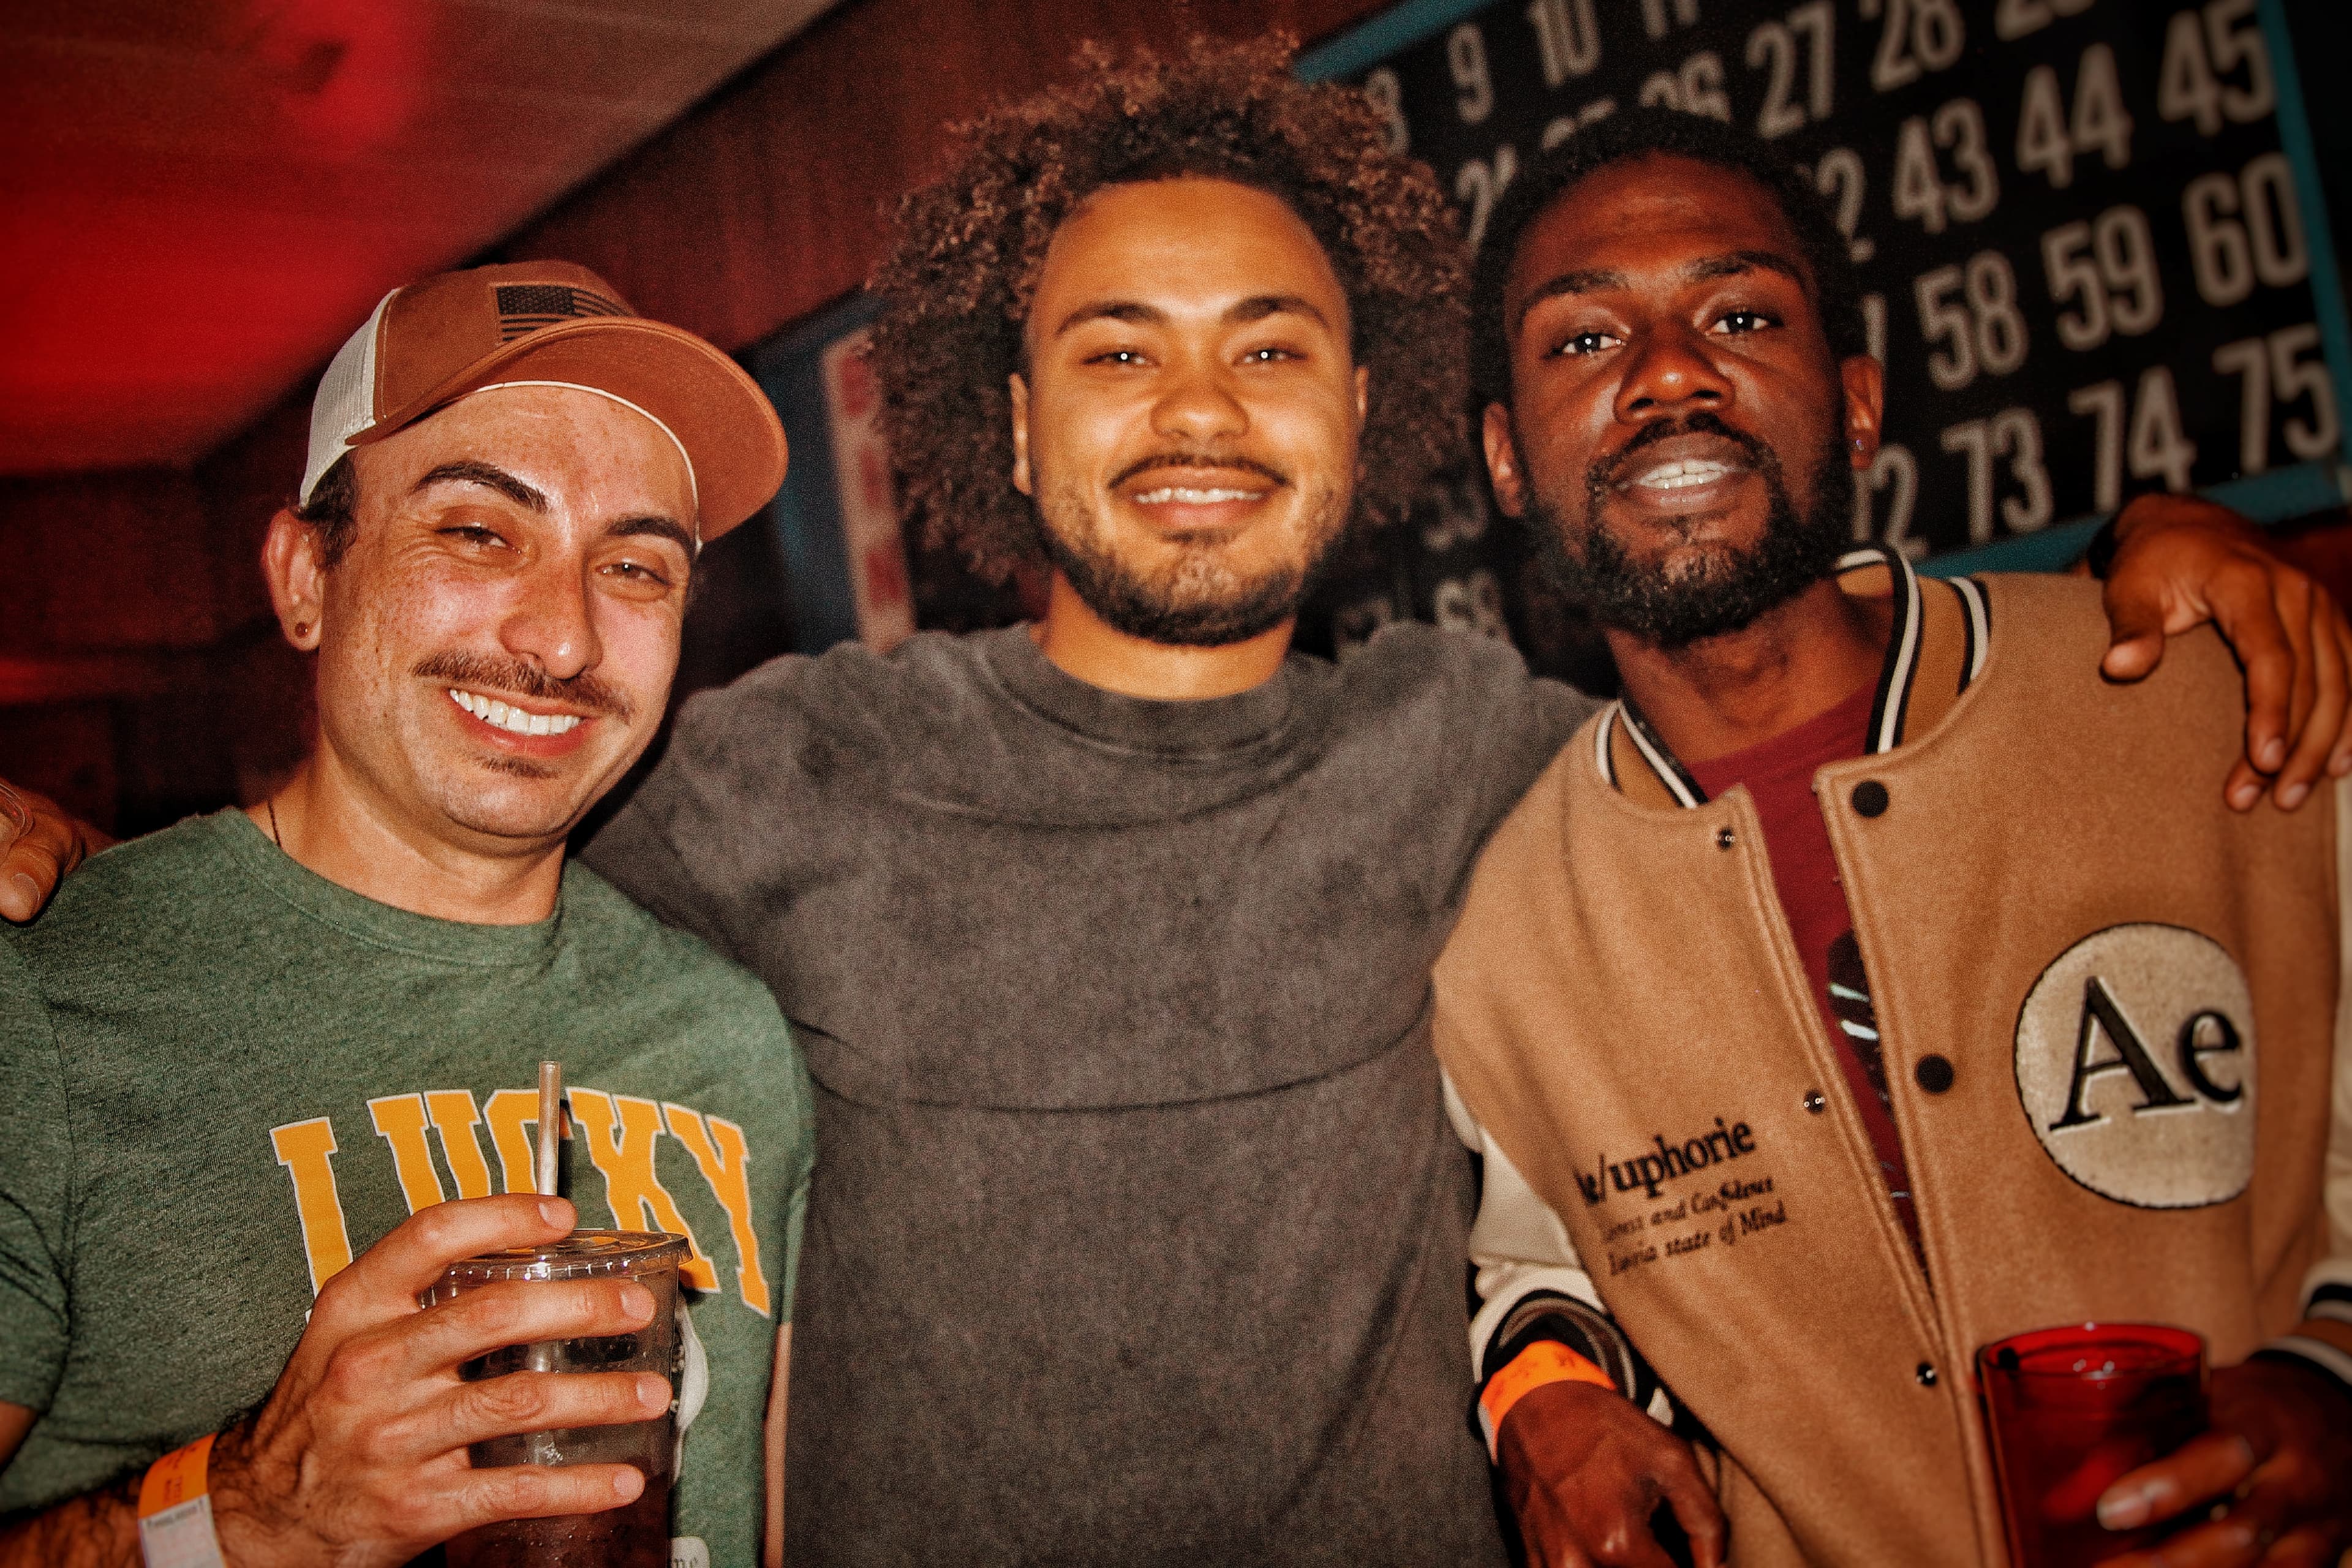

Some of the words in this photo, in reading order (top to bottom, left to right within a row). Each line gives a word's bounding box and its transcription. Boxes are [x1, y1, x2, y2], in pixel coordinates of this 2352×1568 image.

[1448, 23, 1494, 121] 9
[1526, 0, 1603, 88] 10
[1744, 2, 1836, 138] 27
[1815, 148, 1875, 263] 2
[1892, 98, 2000, 235] 43
[2016, 42, 2135, 189] 44
[2158, 0, 2277, 136] 45
[1915, 249, 2029, 391] 58
[2041, 205, 2164, 350] 59
[2182, 151, 2310, 307] 60
[1940, 407, 2054, 543] 73
[2068, 367, 2198, 513] 74
[2212, 322, 2340, 475] 75
[2049, 975, 2243, 1131] Ae
